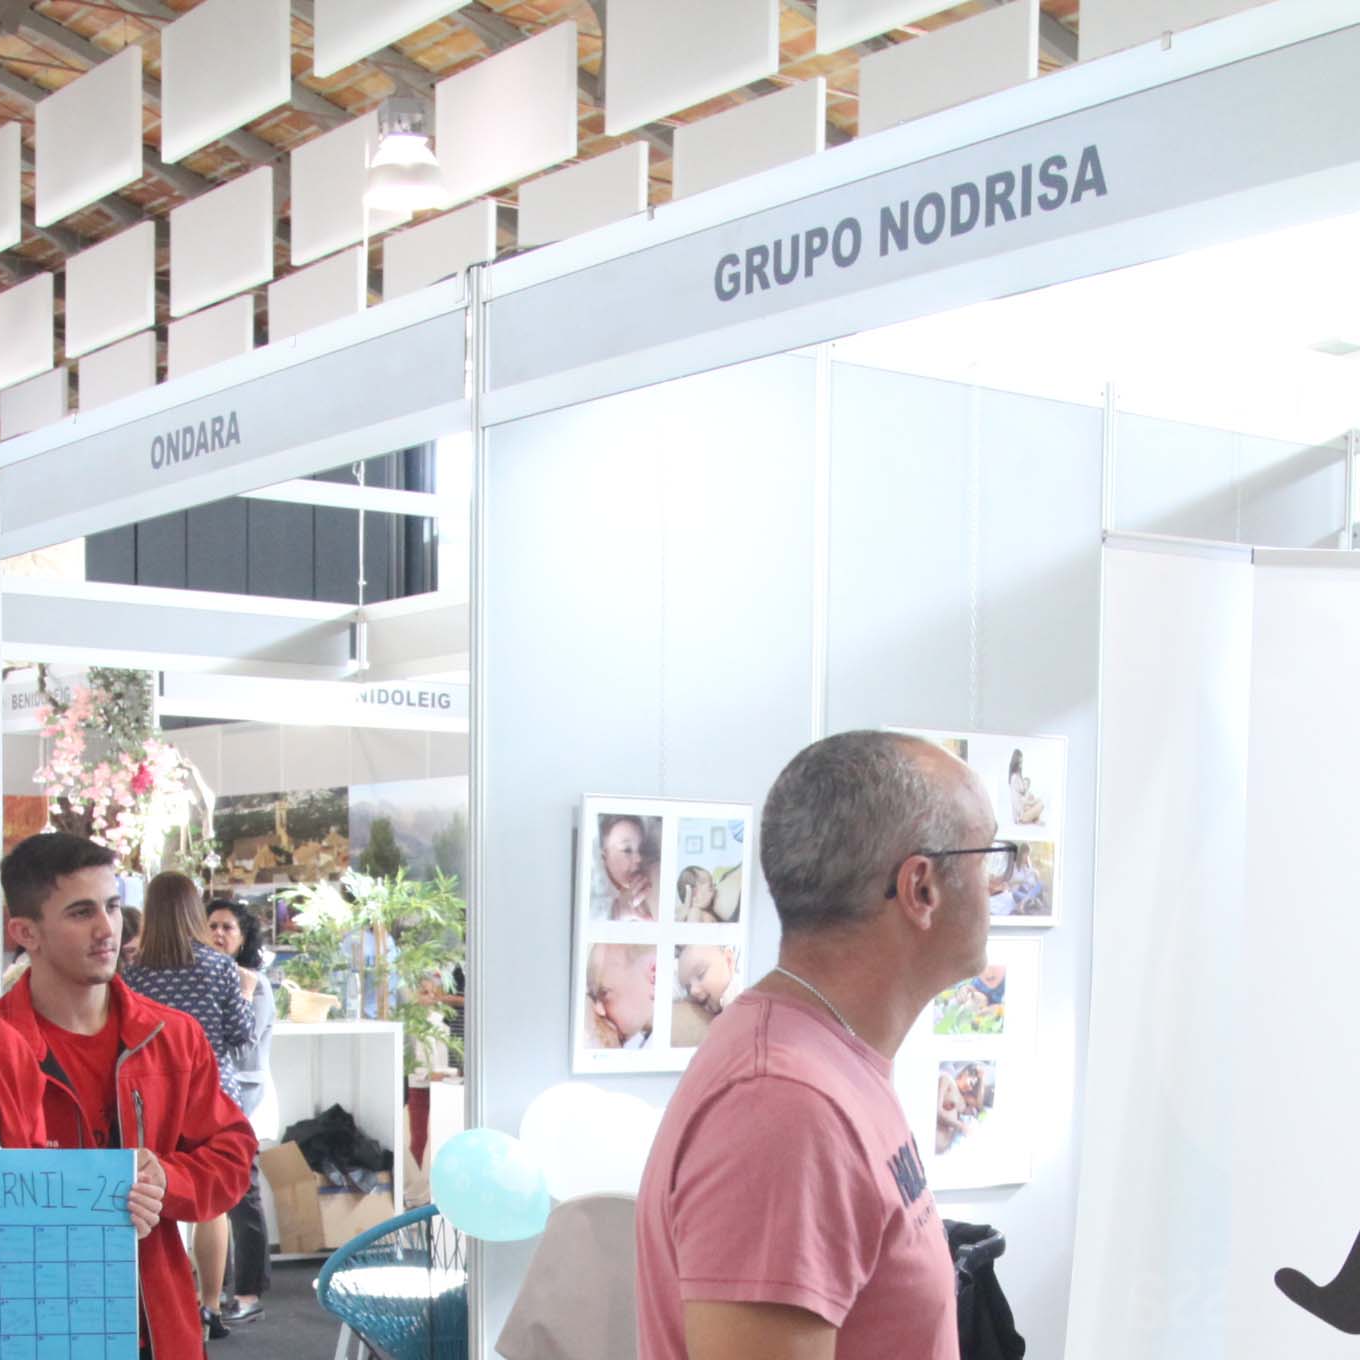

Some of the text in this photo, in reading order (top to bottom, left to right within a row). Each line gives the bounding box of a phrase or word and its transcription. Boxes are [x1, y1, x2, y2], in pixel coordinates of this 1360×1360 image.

[713, 144, 1108, 302] GRUPO NODRISA
[150, 409, 241, 470] ONDARA
